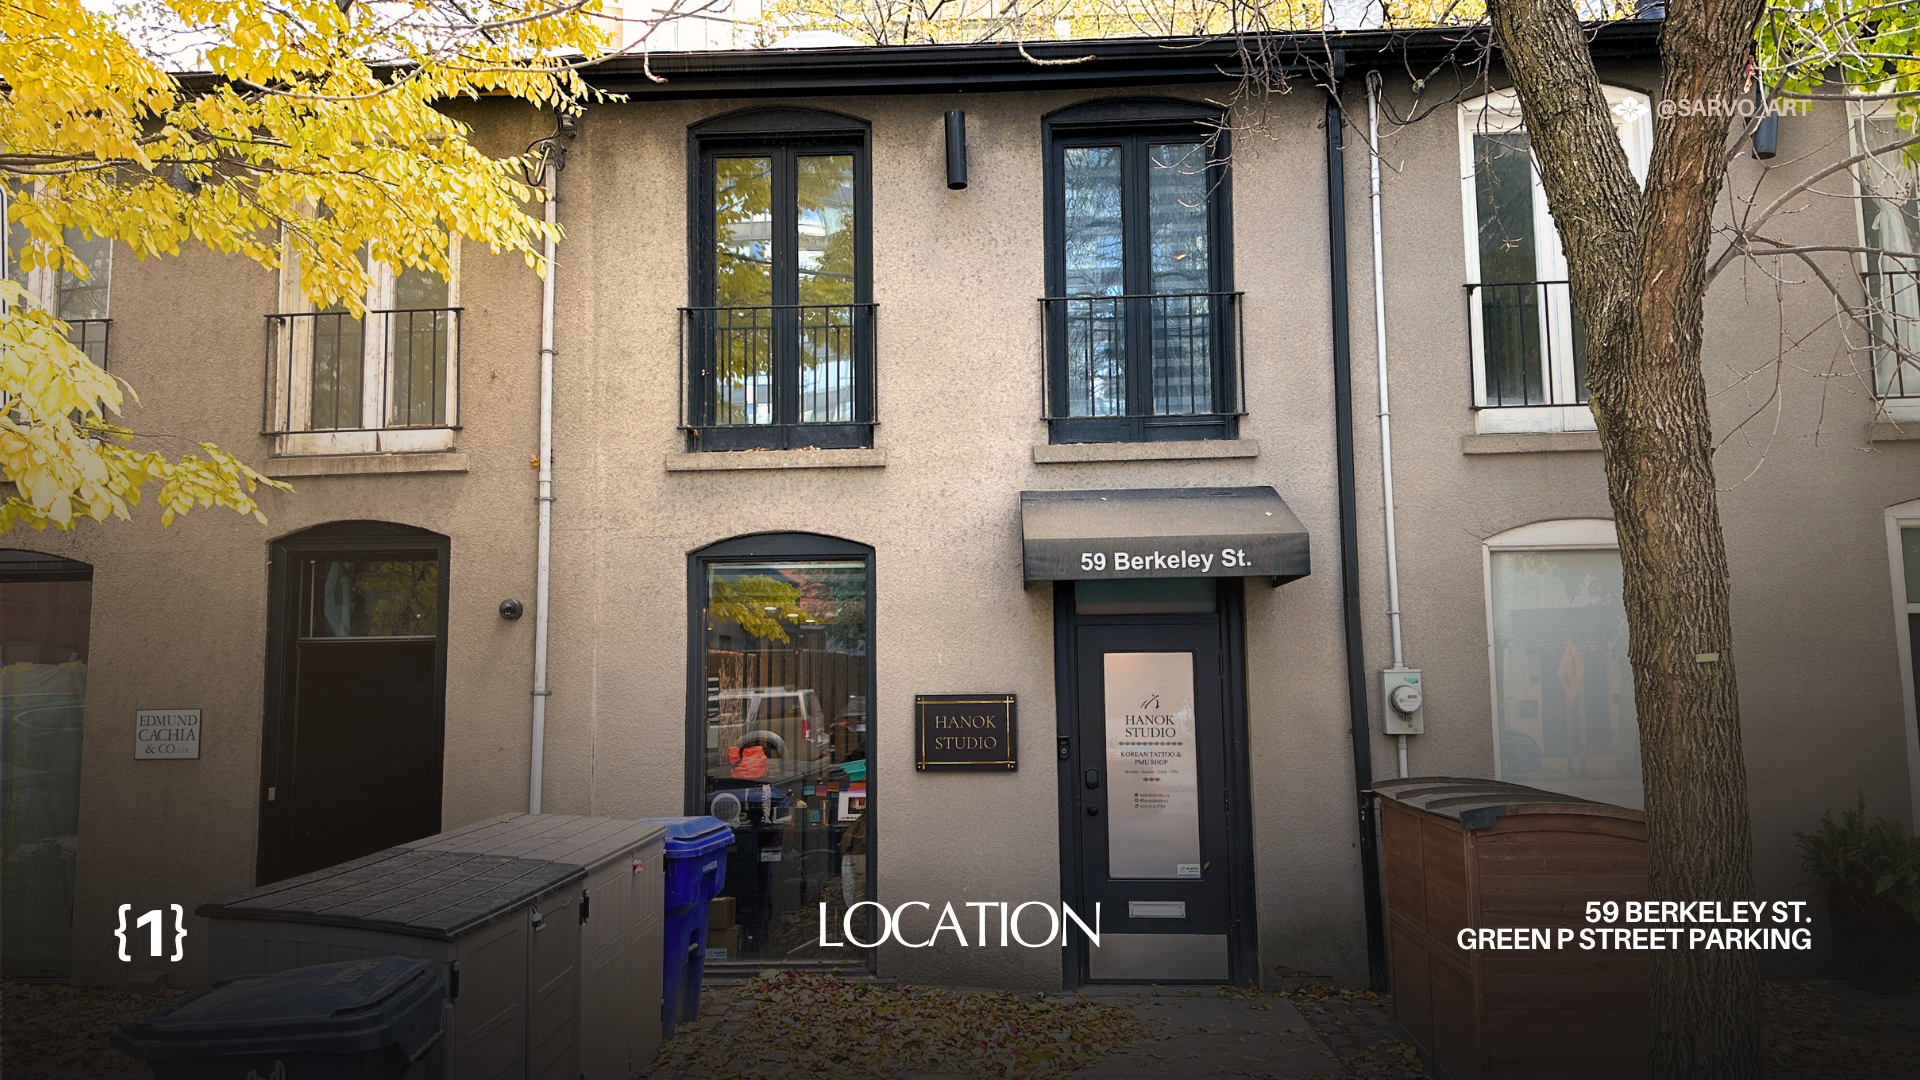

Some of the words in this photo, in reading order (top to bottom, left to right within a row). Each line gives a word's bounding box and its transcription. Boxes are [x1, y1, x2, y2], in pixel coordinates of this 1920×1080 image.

[1081, 552, 1106, 571] 59
[1114, 550, 1214, 573] Berkeley
[1221, 548, 1252, 568] St.
[139, 715, 198, 726] EDMUND
[934, 715, 997, 729] HANOK
[1125, 714, 1175, 726] HANOK
[138, 728, 196, 742] CACHIA
[1125, 727, 1176, 738] STUDIO
[145, 744, 155, 754] &
[935, 736, 997, 750] STUDIO
